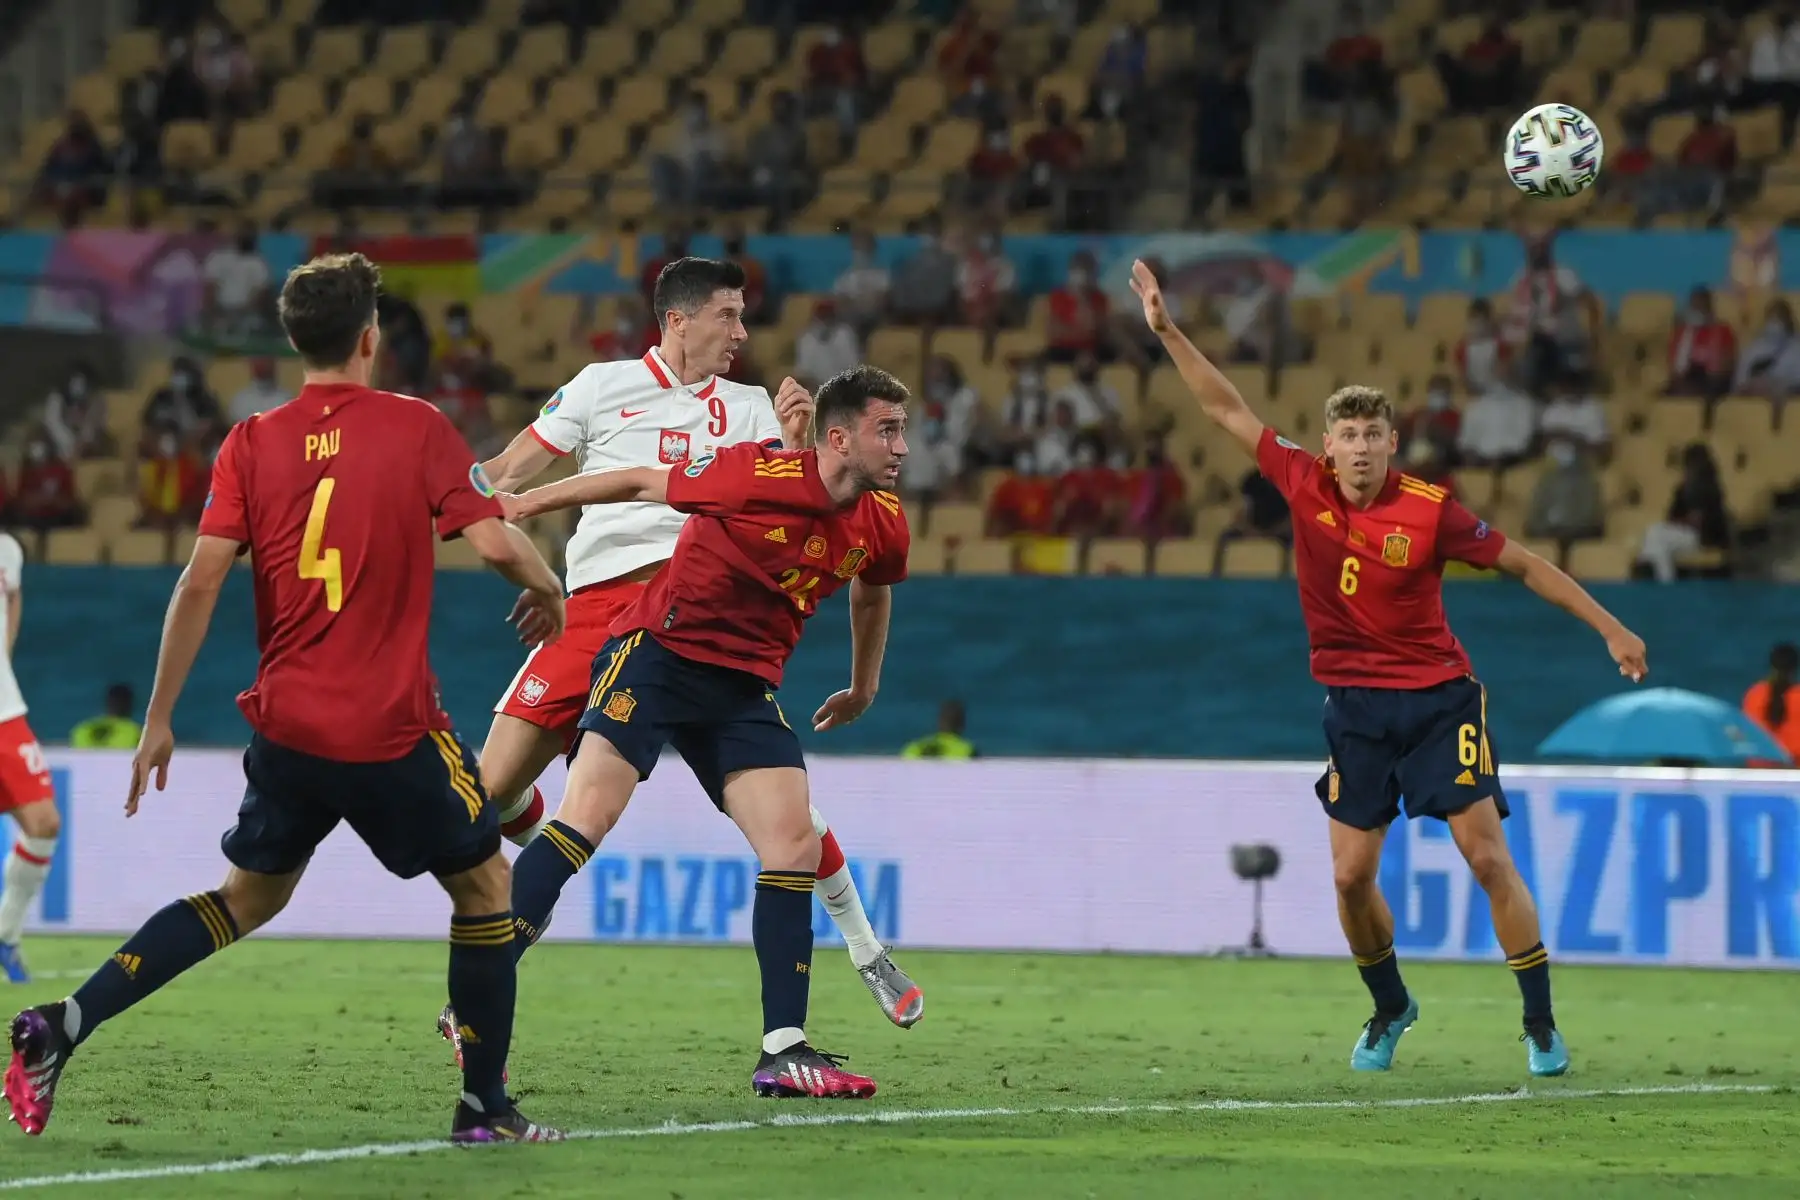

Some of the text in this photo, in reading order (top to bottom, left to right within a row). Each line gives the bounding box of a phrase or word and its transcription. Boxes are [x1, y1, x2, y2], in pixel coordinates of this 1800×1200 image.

[708, 397, 727, 437] 9
[305, 428, 340, 462] PAU
[297, 477, 342, 613] 4
[779, 568, 820, 611] 24
[1340, 556, 1360, 595] 6
[1458, 723, 1477, 767] 6
[593, 855, 899, 940] GAZPM
